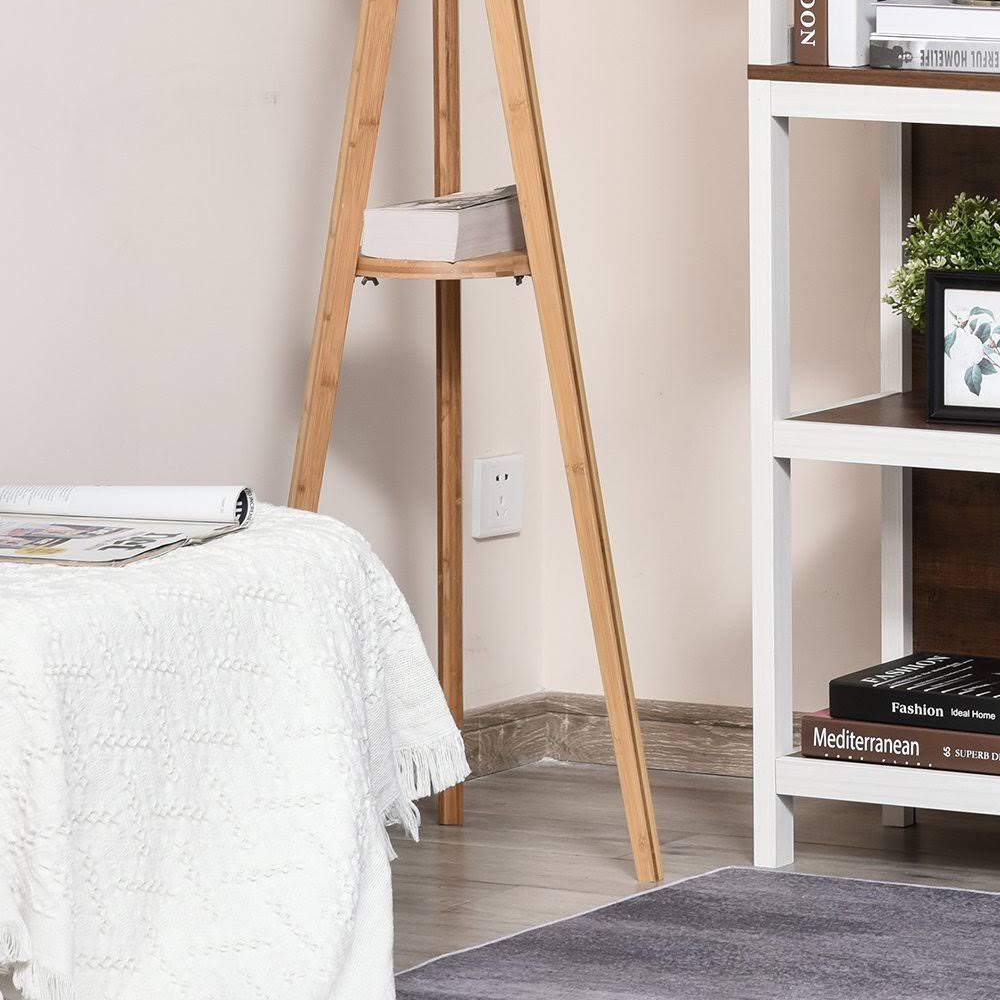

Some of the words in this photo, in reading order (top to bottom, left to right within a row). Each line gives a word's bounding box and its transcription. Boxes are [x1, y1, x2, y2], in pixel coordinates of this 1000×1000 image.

[920, 49, 968, 68] HOMELIFE
[861, 655, 950, 683] FASHION
[891, 701, 944, 717] Fashion
[951, 708, 970, 718] Ideal
[972, 710, 996, 720] Home
[813, 726, 920, 756] Mediterranean
[955, 749, 990, 760] SUPERB
